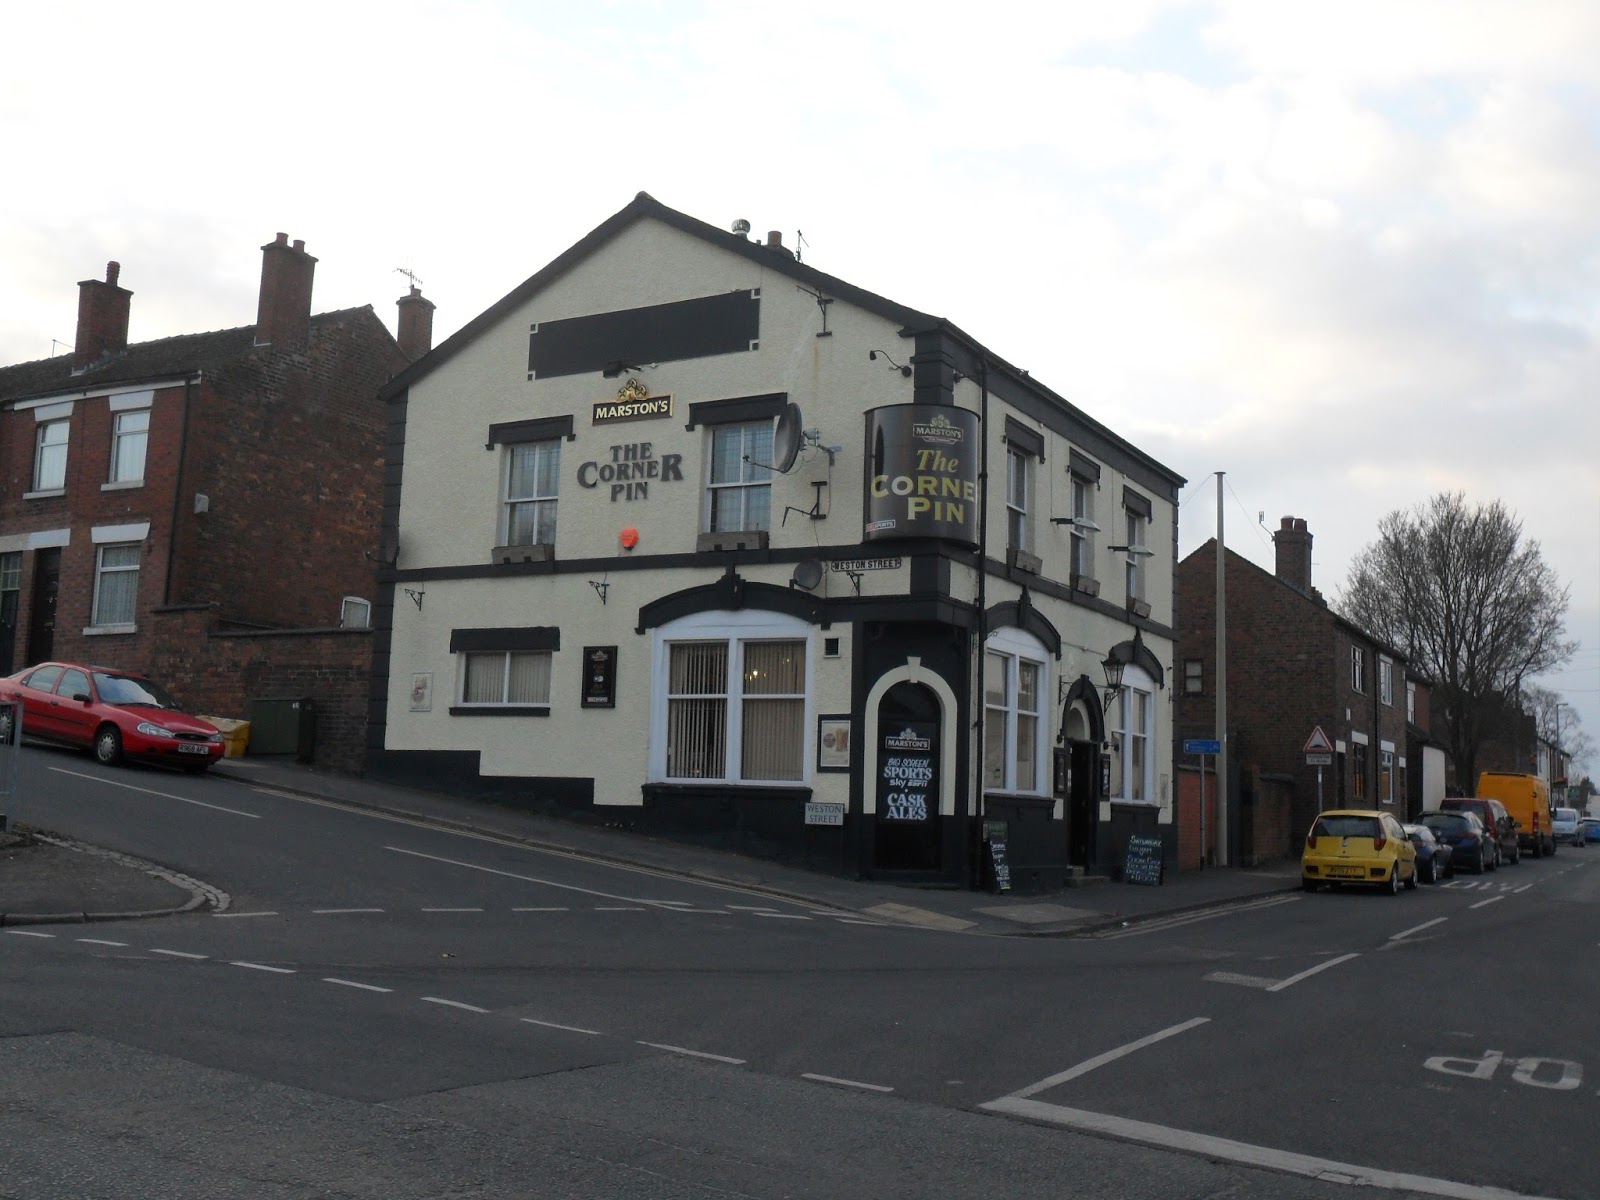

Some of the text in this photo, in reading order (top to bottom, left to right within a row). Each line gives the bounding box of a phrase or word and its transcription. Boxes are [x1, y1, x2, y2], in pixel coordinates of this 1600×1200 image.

[595, 400, 669, 419] MARSTON'S
[915, 427, 962, 439] MARSTON'S
[609, 442, 652, 463] THE
[916, 449, 959, 473] The
[576, 453, 684, 490] CORNER
[610, 481, 649, 503] PIN
[870, 475, 977, 503] CORNE
[906, 497, 964, 524] PIN
[834, 559, 898, 570] WESTON STREET
[887, 739, 928, 748] MARSTON'S
[887, 758, 929, 767] BIG SCREEN
[883, 766, 932, 779] SPORTS
[889, 778, 907, 788] sky
[887, 793, 927, 807] CASK
[807, 804, 842, 813] WESTON
[886, 807, 928, 820] ALES
[809, 815, 838, 823] STREET
